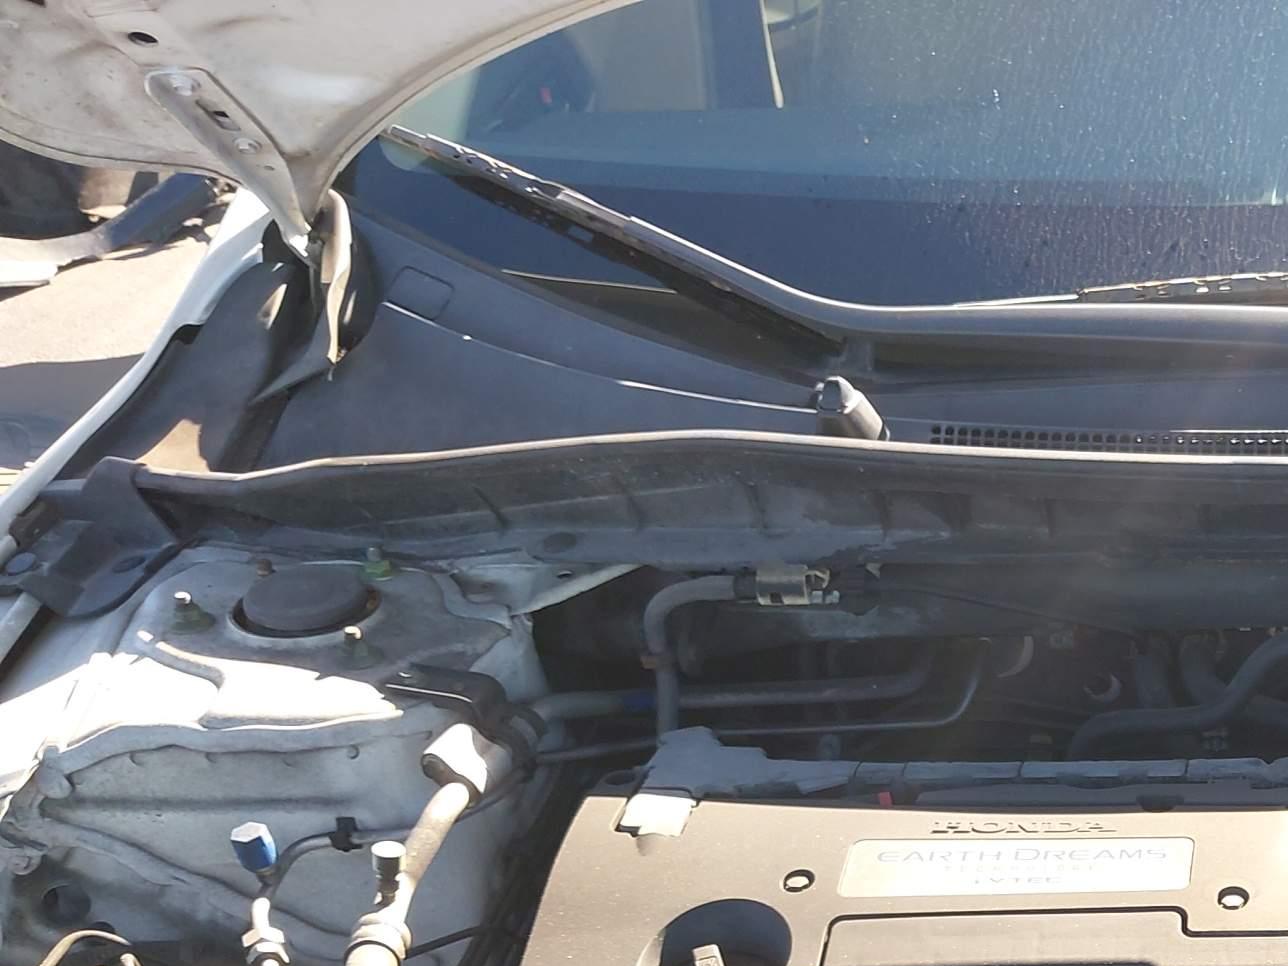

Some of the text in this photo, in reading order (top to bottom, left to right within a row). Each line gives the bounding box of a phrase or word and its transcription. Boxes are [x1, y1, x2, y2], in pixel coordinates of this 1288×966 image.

[930, 821, 1117, 834] HONDA
[877, 847, 1168, 864] EARTH DREAMS
